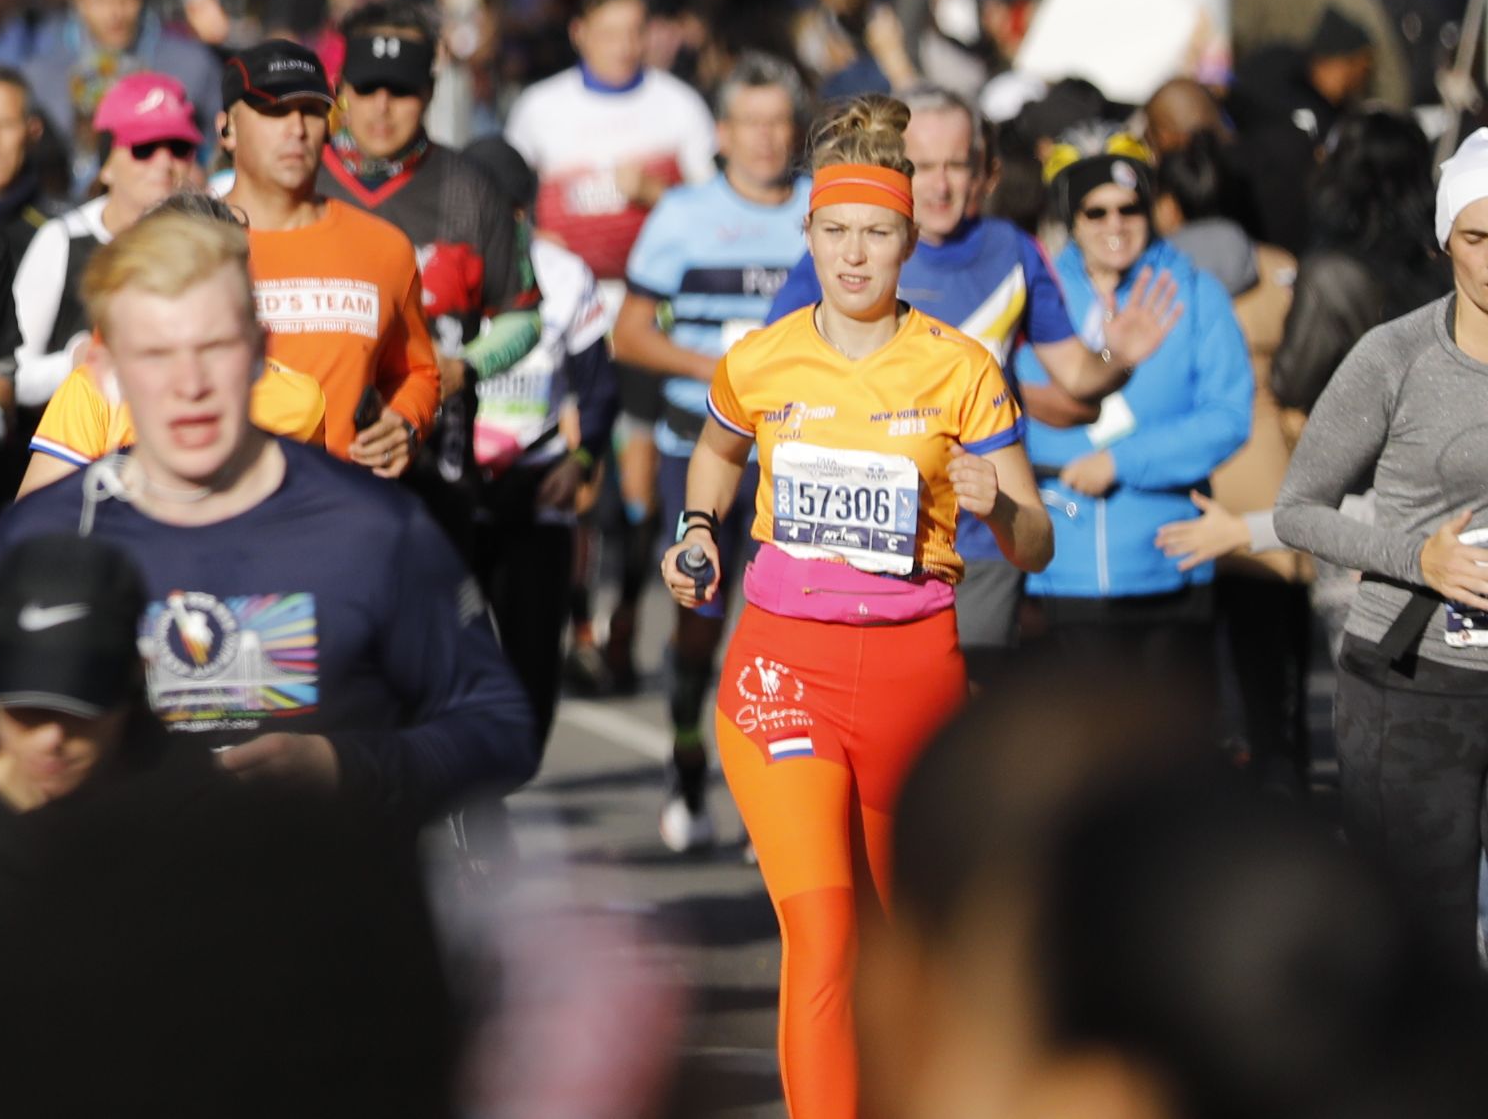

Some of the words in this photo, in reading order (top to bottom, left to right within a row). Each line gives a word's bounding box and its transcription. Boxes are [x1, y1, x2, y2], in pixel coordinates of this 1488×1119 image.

[312, 293, 373, 315] TEAM
[777, 478, 791, 515] 2019
[798, 481, 890, 525] 57306
